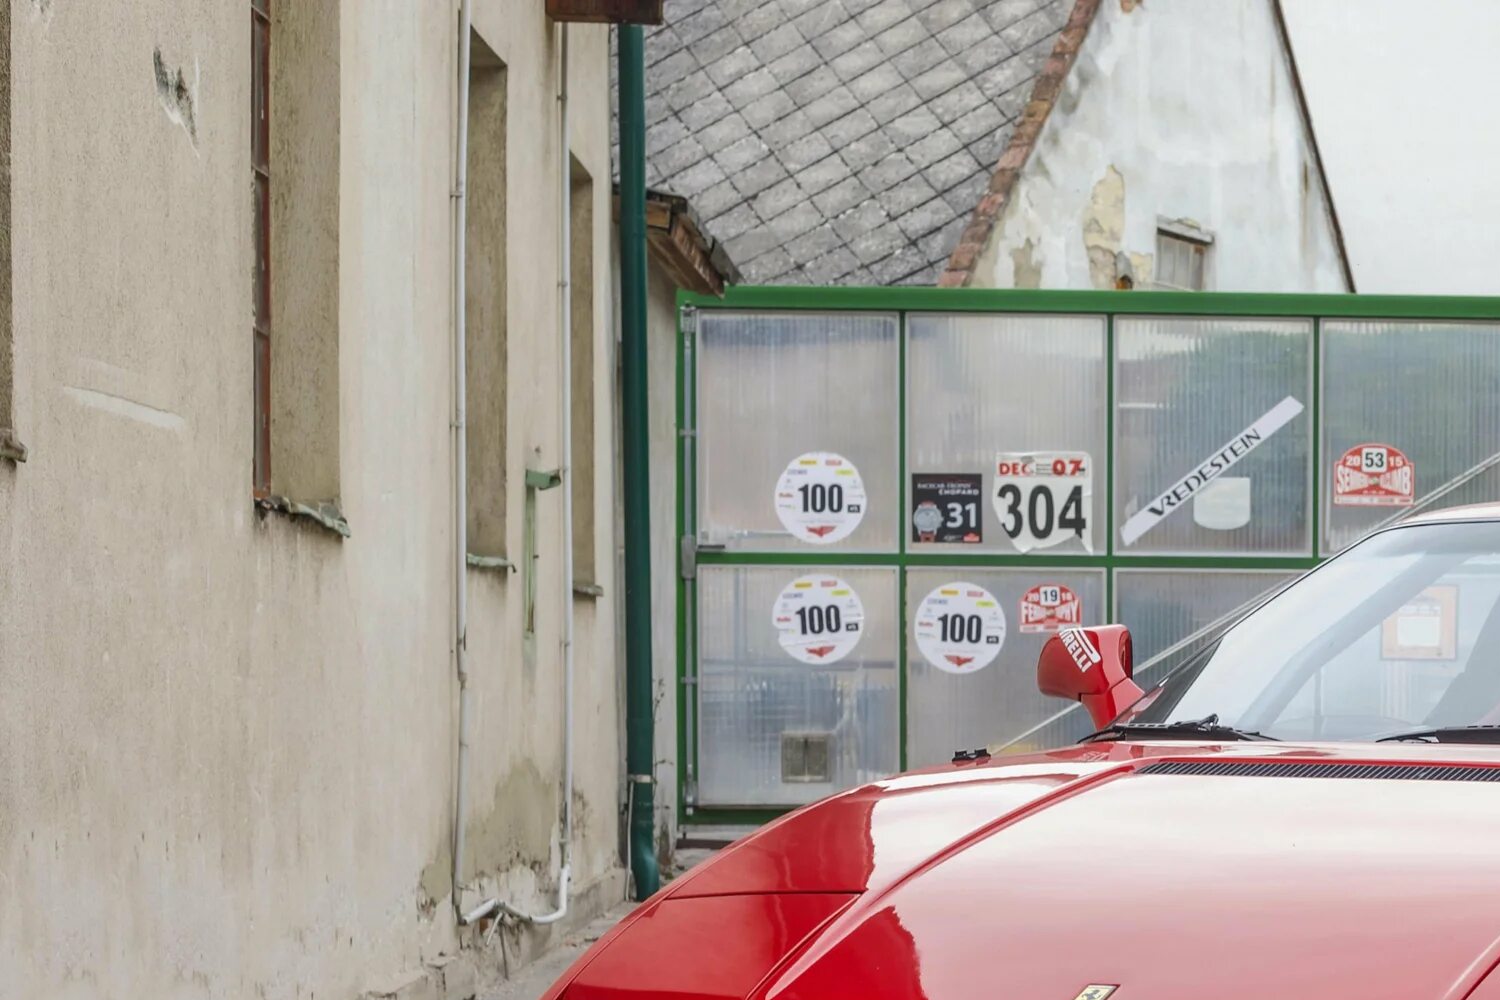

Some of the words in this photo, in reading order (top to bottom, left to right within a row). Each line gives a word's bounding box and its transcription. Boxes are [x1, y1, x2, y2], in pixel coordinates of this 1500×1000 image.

[1147, 428, 1261, 517] VREDESTEIN
[1365, 452, 1384, 468] 53
[798, 483, 843, 513] 100
[997, 483, 1086, 539] 304
[946, 502, 976, 528] 31
[1042, 590, 1058, 602] 19
[795, 604, 841, 635] 100
[937, 613, 982, 644] 100
